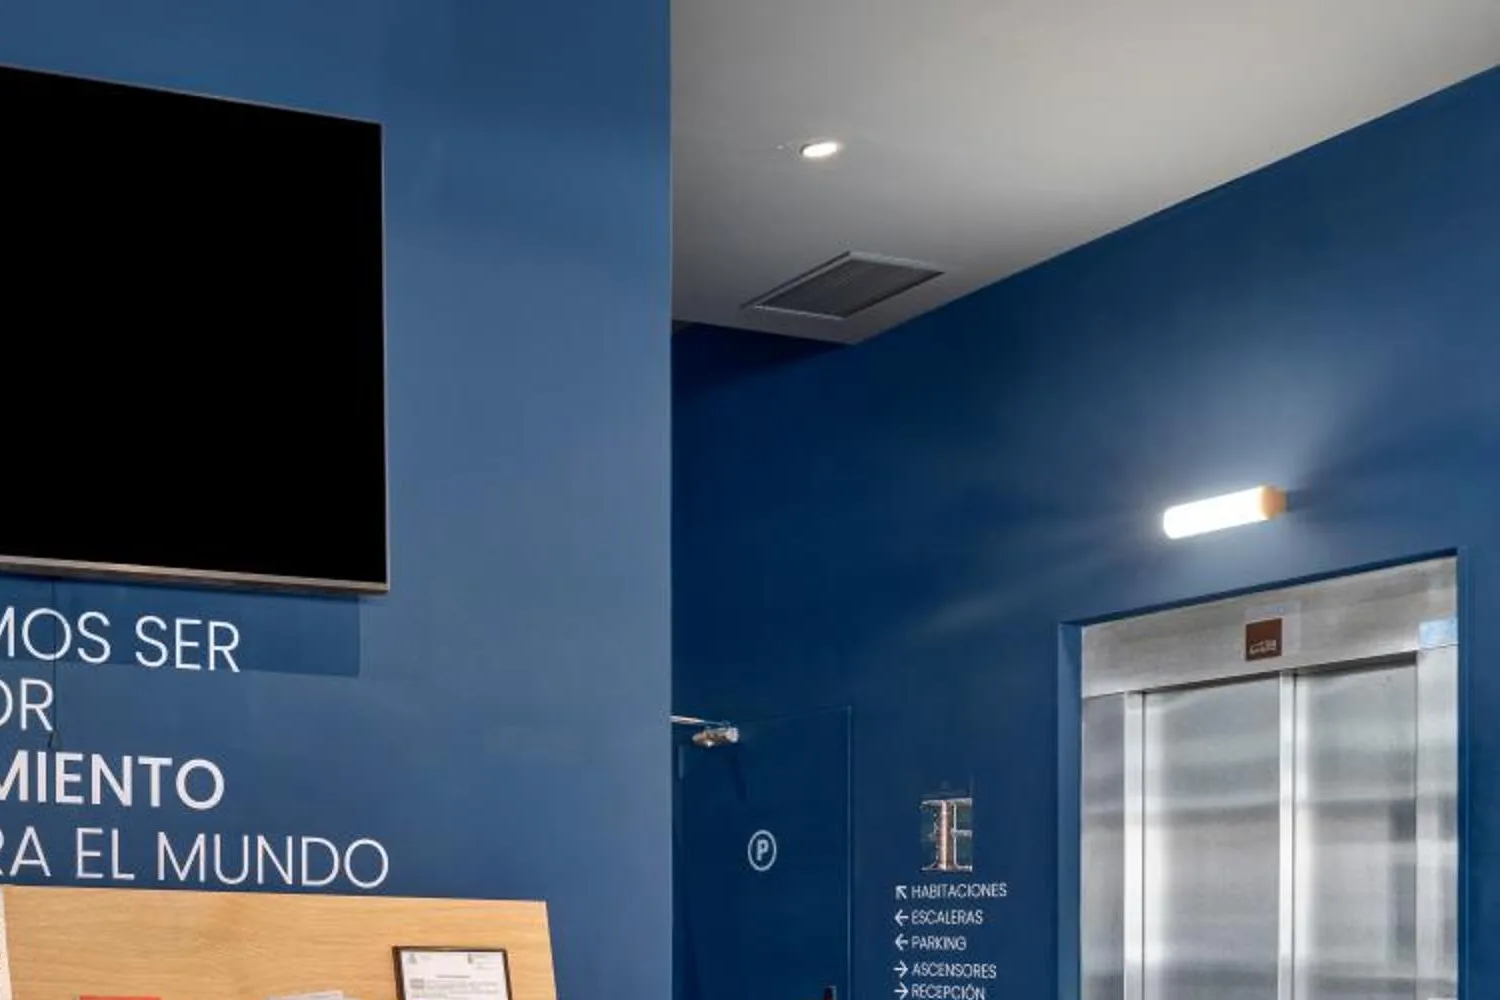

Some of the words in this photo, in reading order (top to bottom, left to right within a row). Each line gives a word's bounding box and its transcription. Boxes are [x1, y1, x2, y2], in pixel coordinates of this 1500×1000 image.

[135, 615, 241, 673] SER
[76, 828, 134, 882] EL
[157, 832, 389, 888] MUNDO
[911, 882, 1007, 899] HABITACIONES
[911, 909, 983, 925] ESCALERAS
[911, 935, 967, 951] PARKING
[911, 962, 997, 979] ASCENSORES
[911, 983, 986, 1000] RECEPCIÓN
